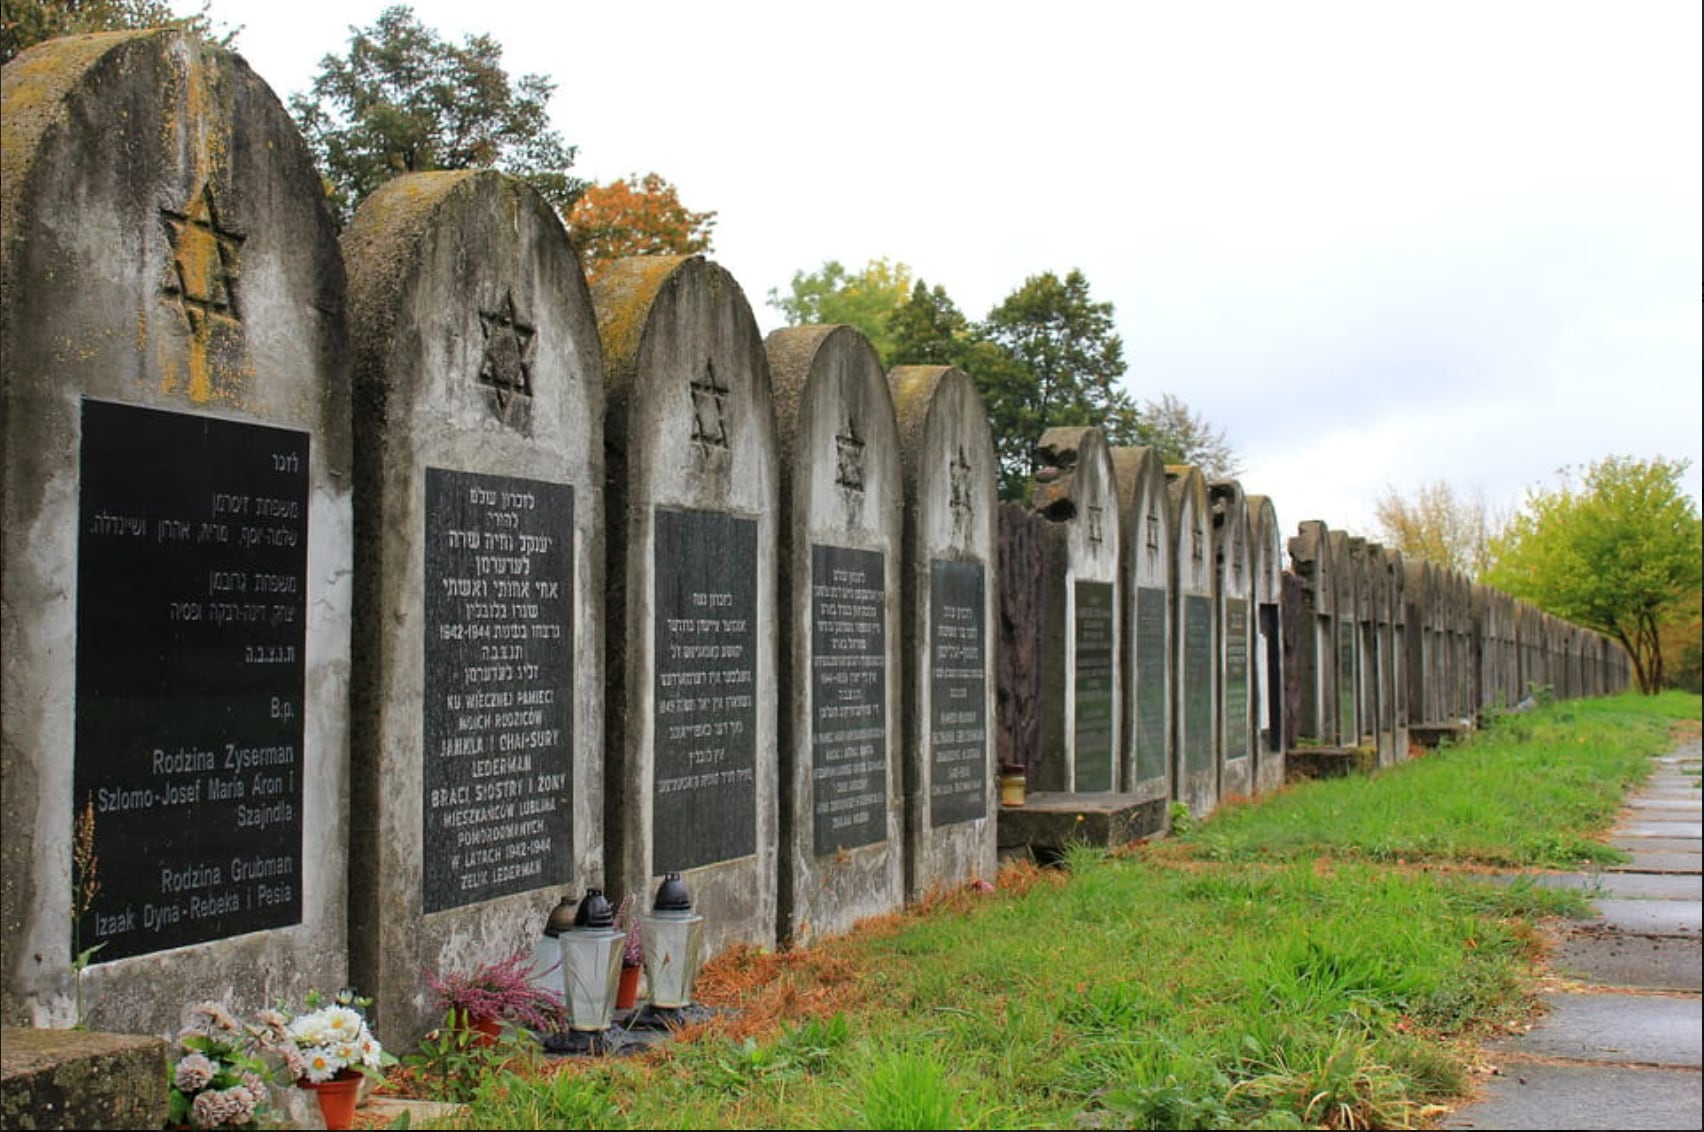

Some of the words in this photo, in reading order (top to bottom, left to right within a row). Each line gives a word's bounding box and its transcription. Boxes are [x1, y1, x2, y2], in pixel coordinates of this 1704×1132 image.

[272, 451, 299, 472] לזכר
[255, 497, 298, 519] משפחת
[448, 530, 481, 549] שרה
[255, 573, 297, 593] משפחת
[442, 578, 488, 597] ואשתי
[493, 579, 530, 598] אחותי
[535, 581, 559, 599] אחי
[271, 696, 295, 724] B.p.
[447, 693, 461, 710] KU
[152, 747, 215, 775] Rodzina
[224, 744, 294, 774] Zyserman
[472, 754, 532, 779] LEDERMAN
[208, 776, 245, 801] Maria
[252, 772, 283, 797] Aron
[288, 770, 295, 793] i
[161, 863, 222, 894] Rodzina
[231, 855, 293, 882] Grubman
[95, 907, 136, 937] Izaak
[257, 881, 293, 908] Pesia
